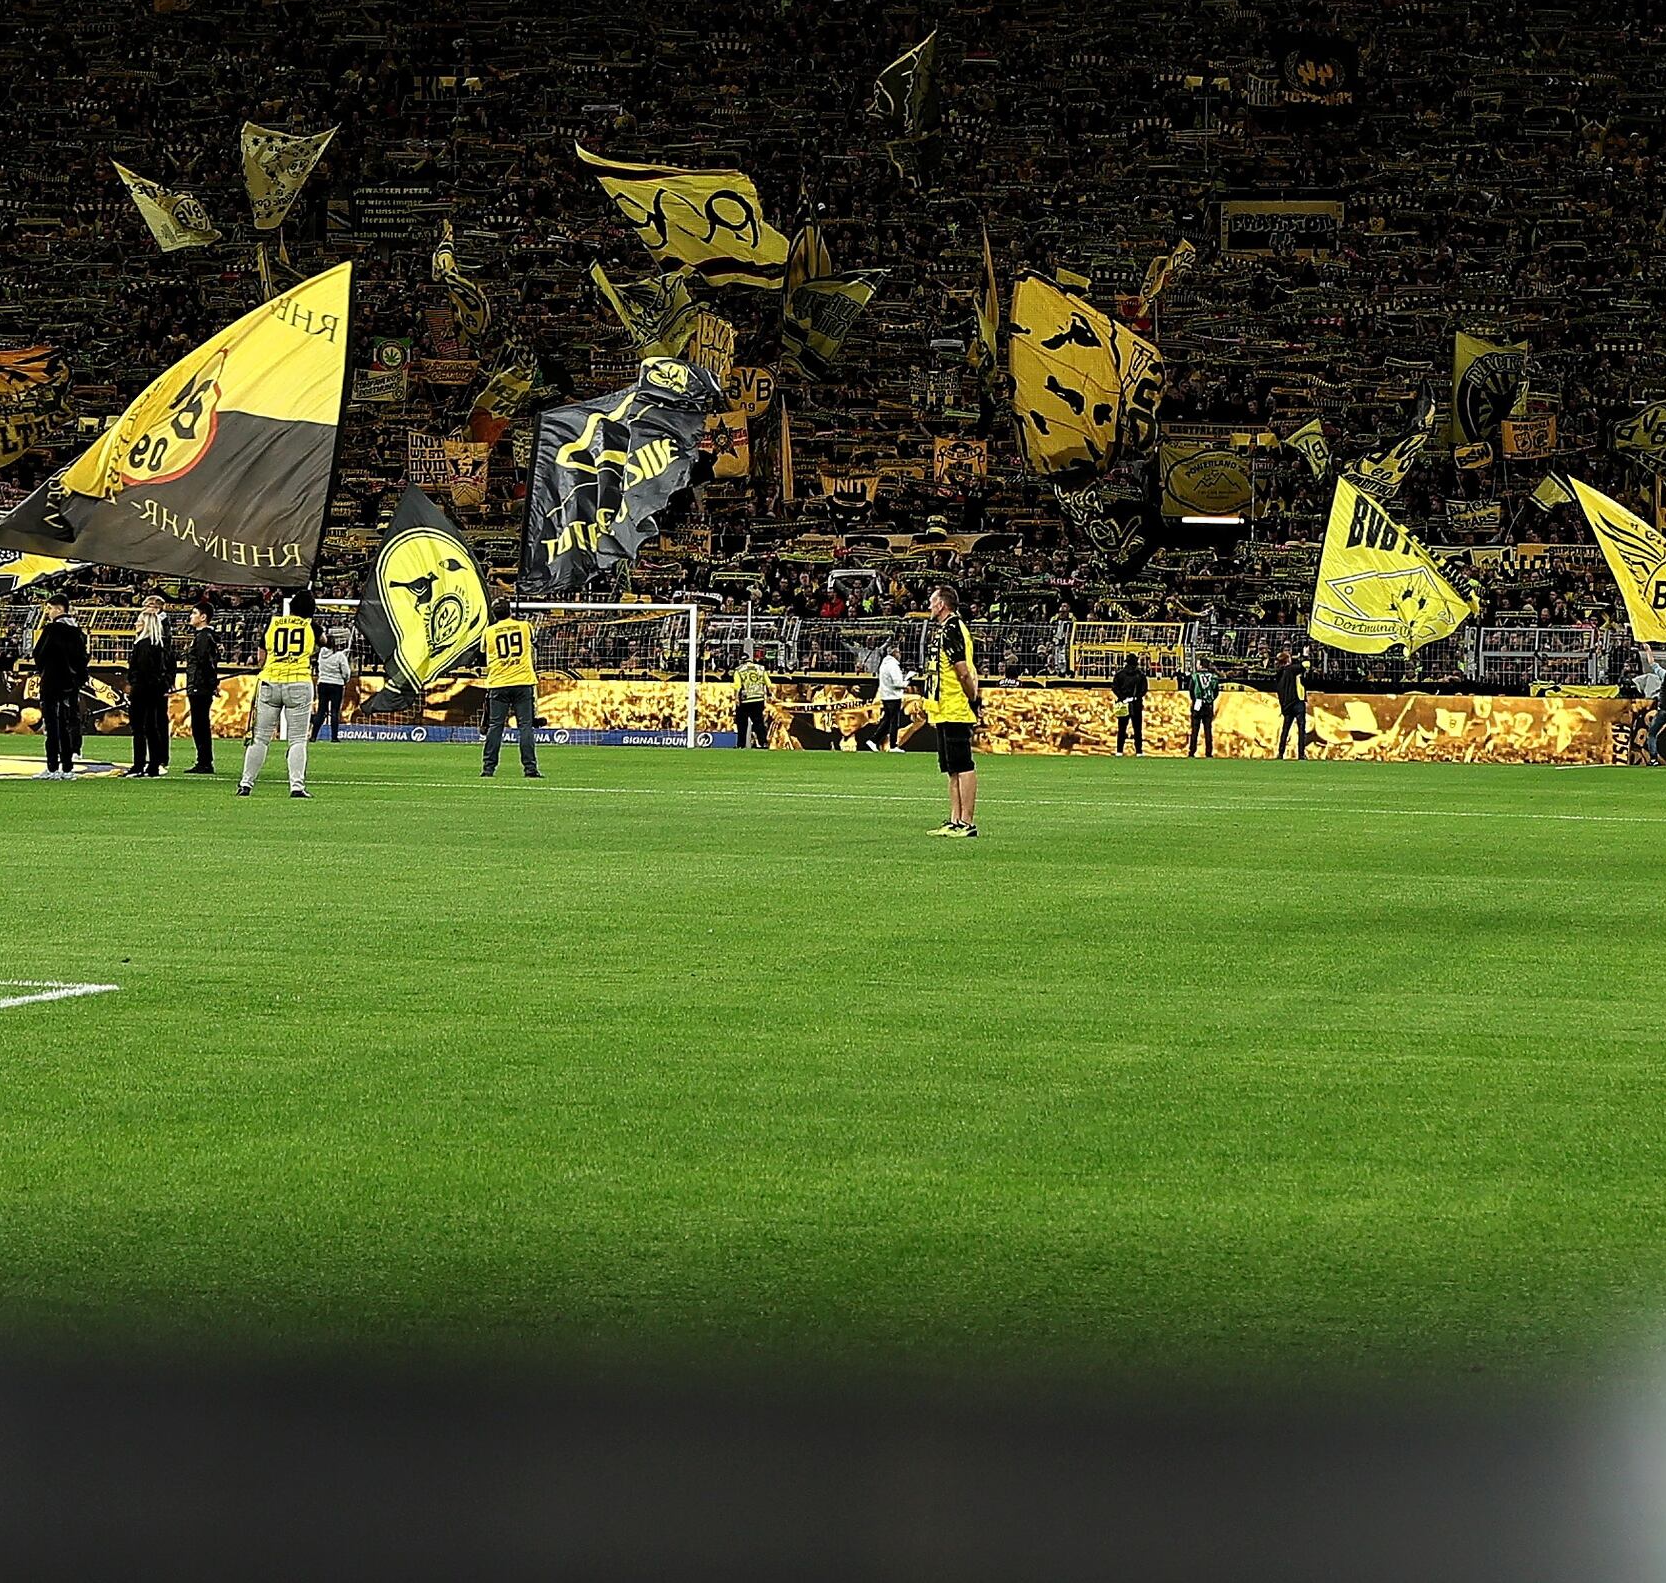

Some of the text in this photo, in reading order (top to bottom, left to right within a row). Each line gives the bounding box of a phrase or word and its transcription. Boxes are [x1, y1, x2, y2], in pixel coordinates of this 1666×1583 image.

[275, 627, 306, 658] 09
[496, 632, 522, 659] 09
[336, 730, 411, 741] SIGNAL IDUNA
[622, 735, 688, 746] SIGNAL IDUN
